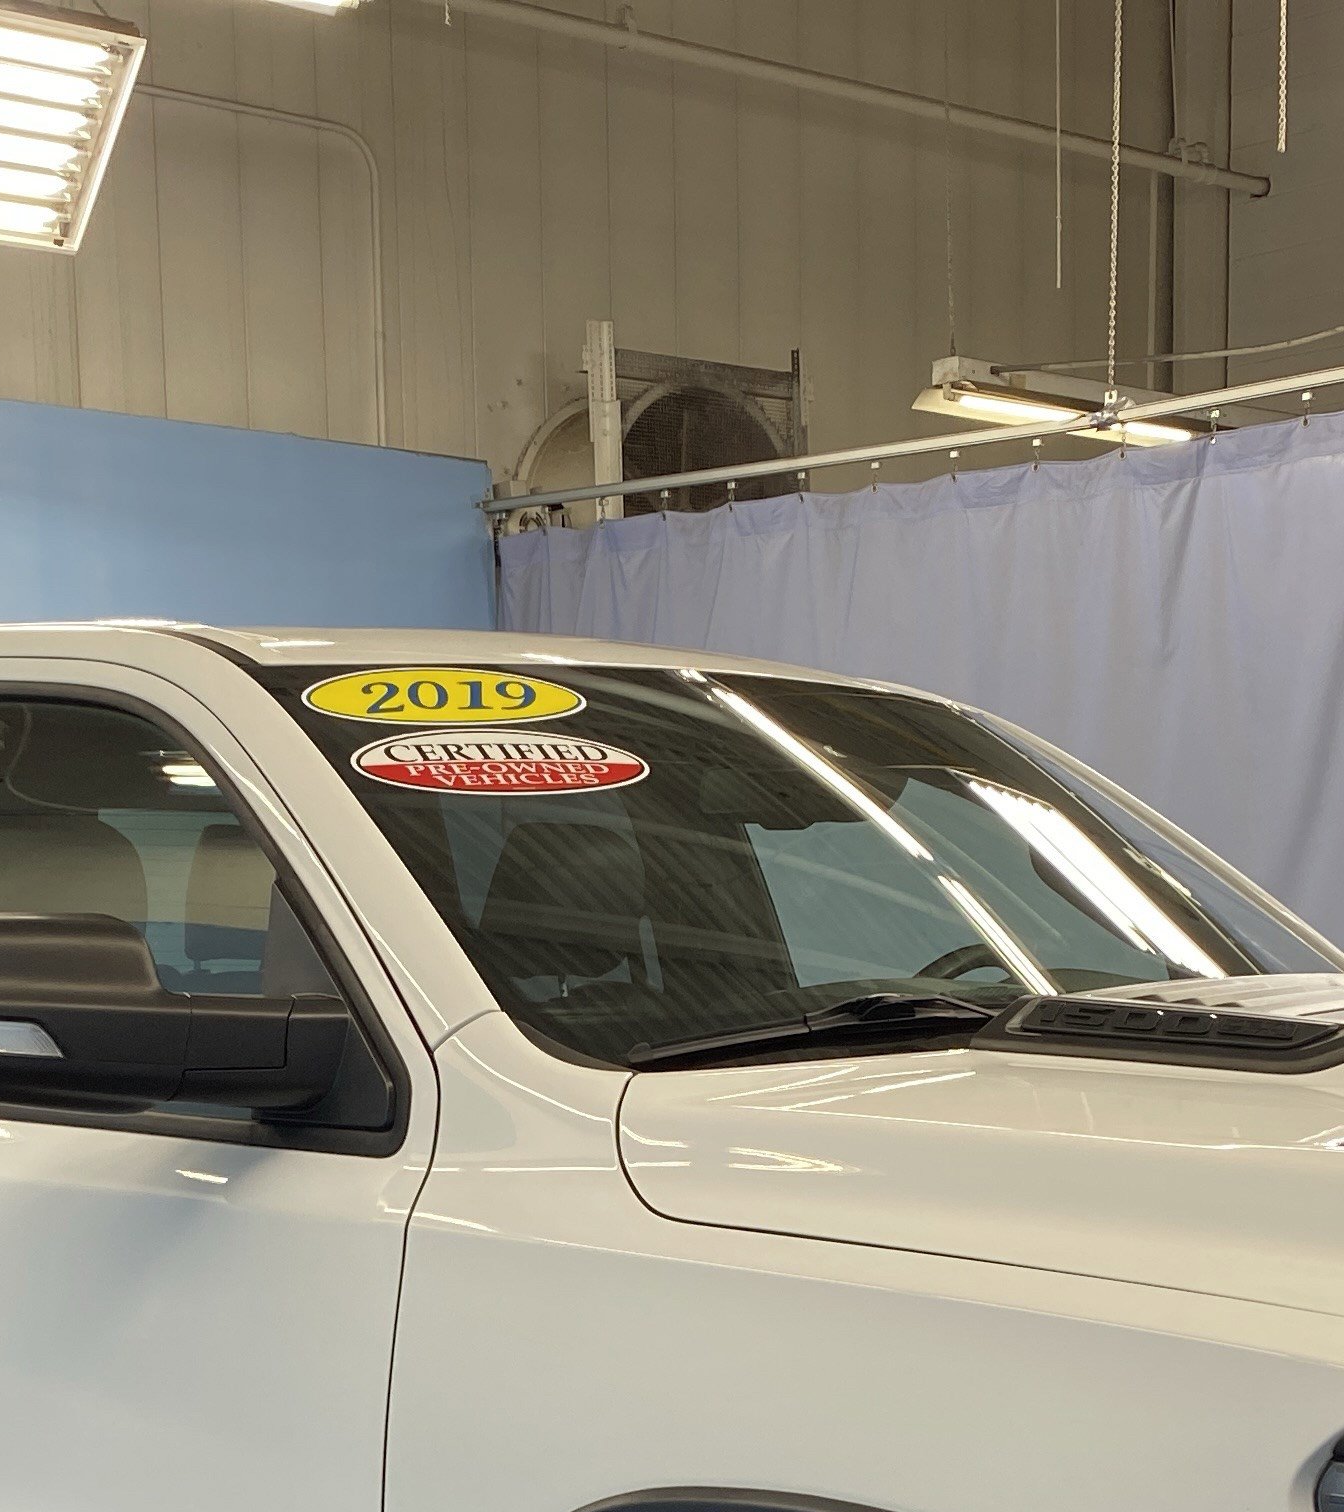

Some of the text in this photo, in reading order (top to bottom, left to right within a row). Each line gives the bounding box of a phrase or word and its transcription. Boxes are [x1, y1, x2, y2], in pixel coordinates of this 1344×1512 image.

[361, 680, 537, 714] 2019
[383, 743, 609, 762] CERTIFIED
[408, 762, 610, 776] PRE-OWNED
[432, 773, 600, 787] VEHICLES
